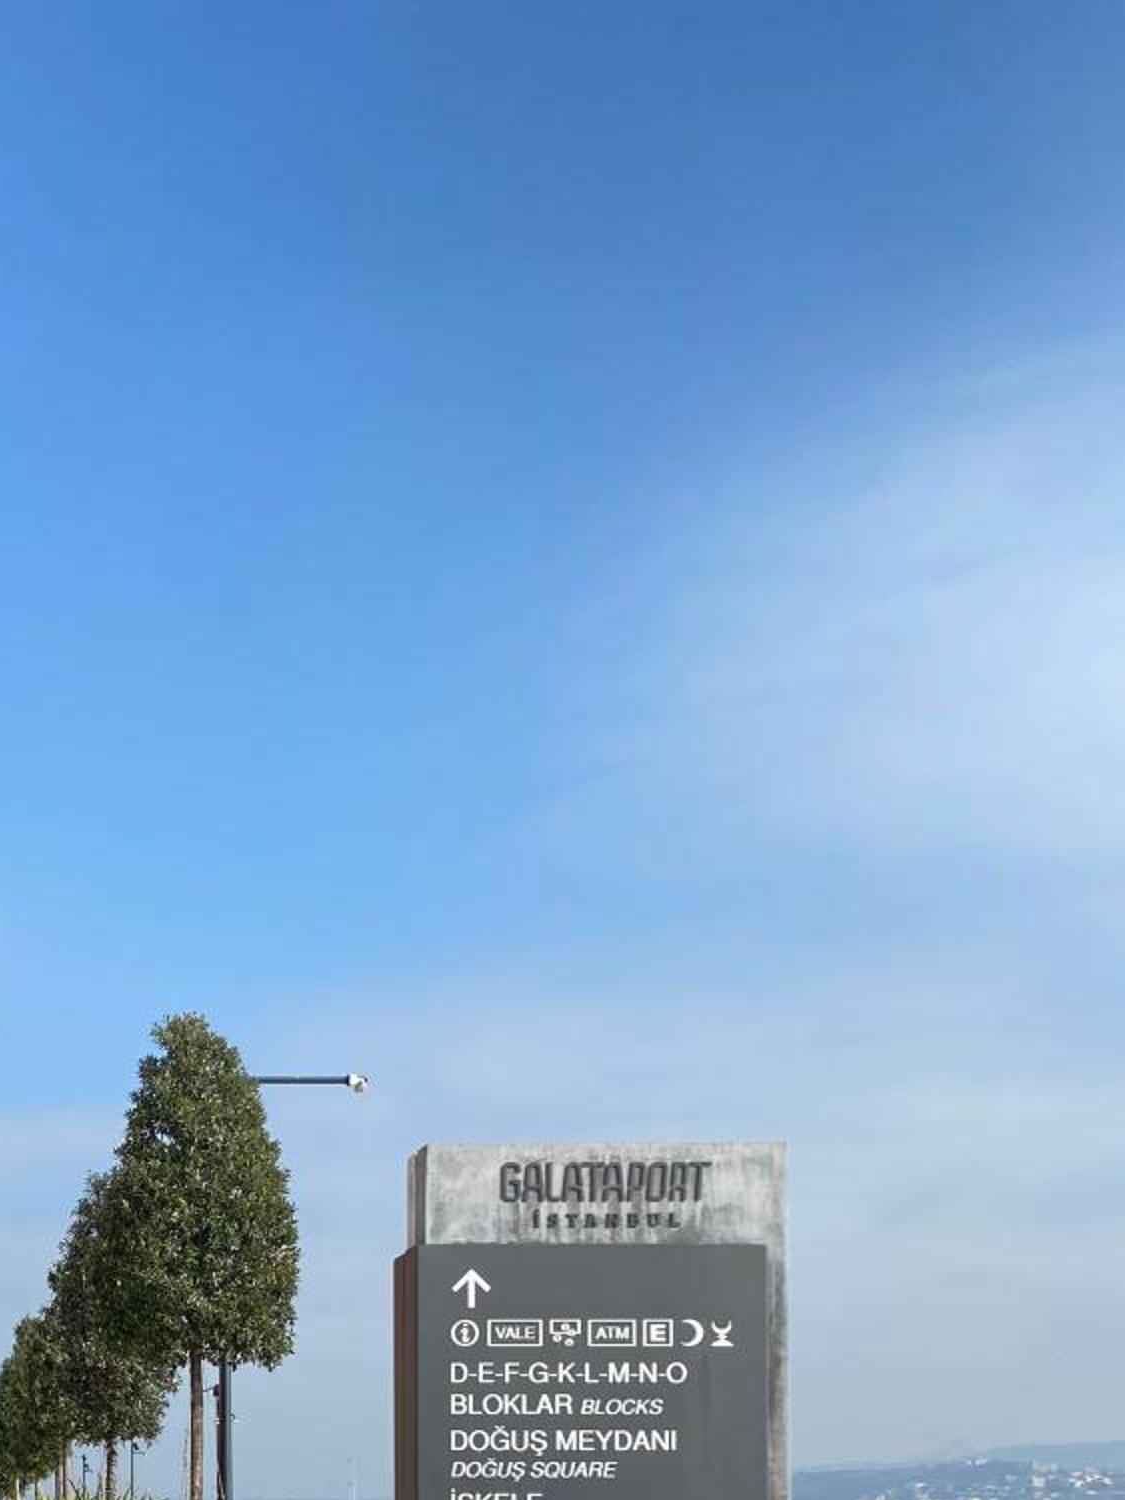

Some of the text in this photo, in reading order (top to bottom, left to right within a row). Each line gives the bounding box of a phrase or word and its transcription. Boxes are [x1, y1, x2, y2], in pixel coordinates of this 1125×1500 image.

[499, 1161, 713, 1203] GALATAPORT
[494, 1324, 537, 1341] VALE
[594, 1325, 631, 1341] ATM
[449, 1360, 689, 1385] D-E-F-G-K-L-M-N-O
[449, 1392, 665, 1416] BLOKLAR BLOCKS
[450, 1424, 678, 1457] DOĞUŞ MEYDANI
[450, 1457, 619, 1483] DOĞUŞ SQUARE
